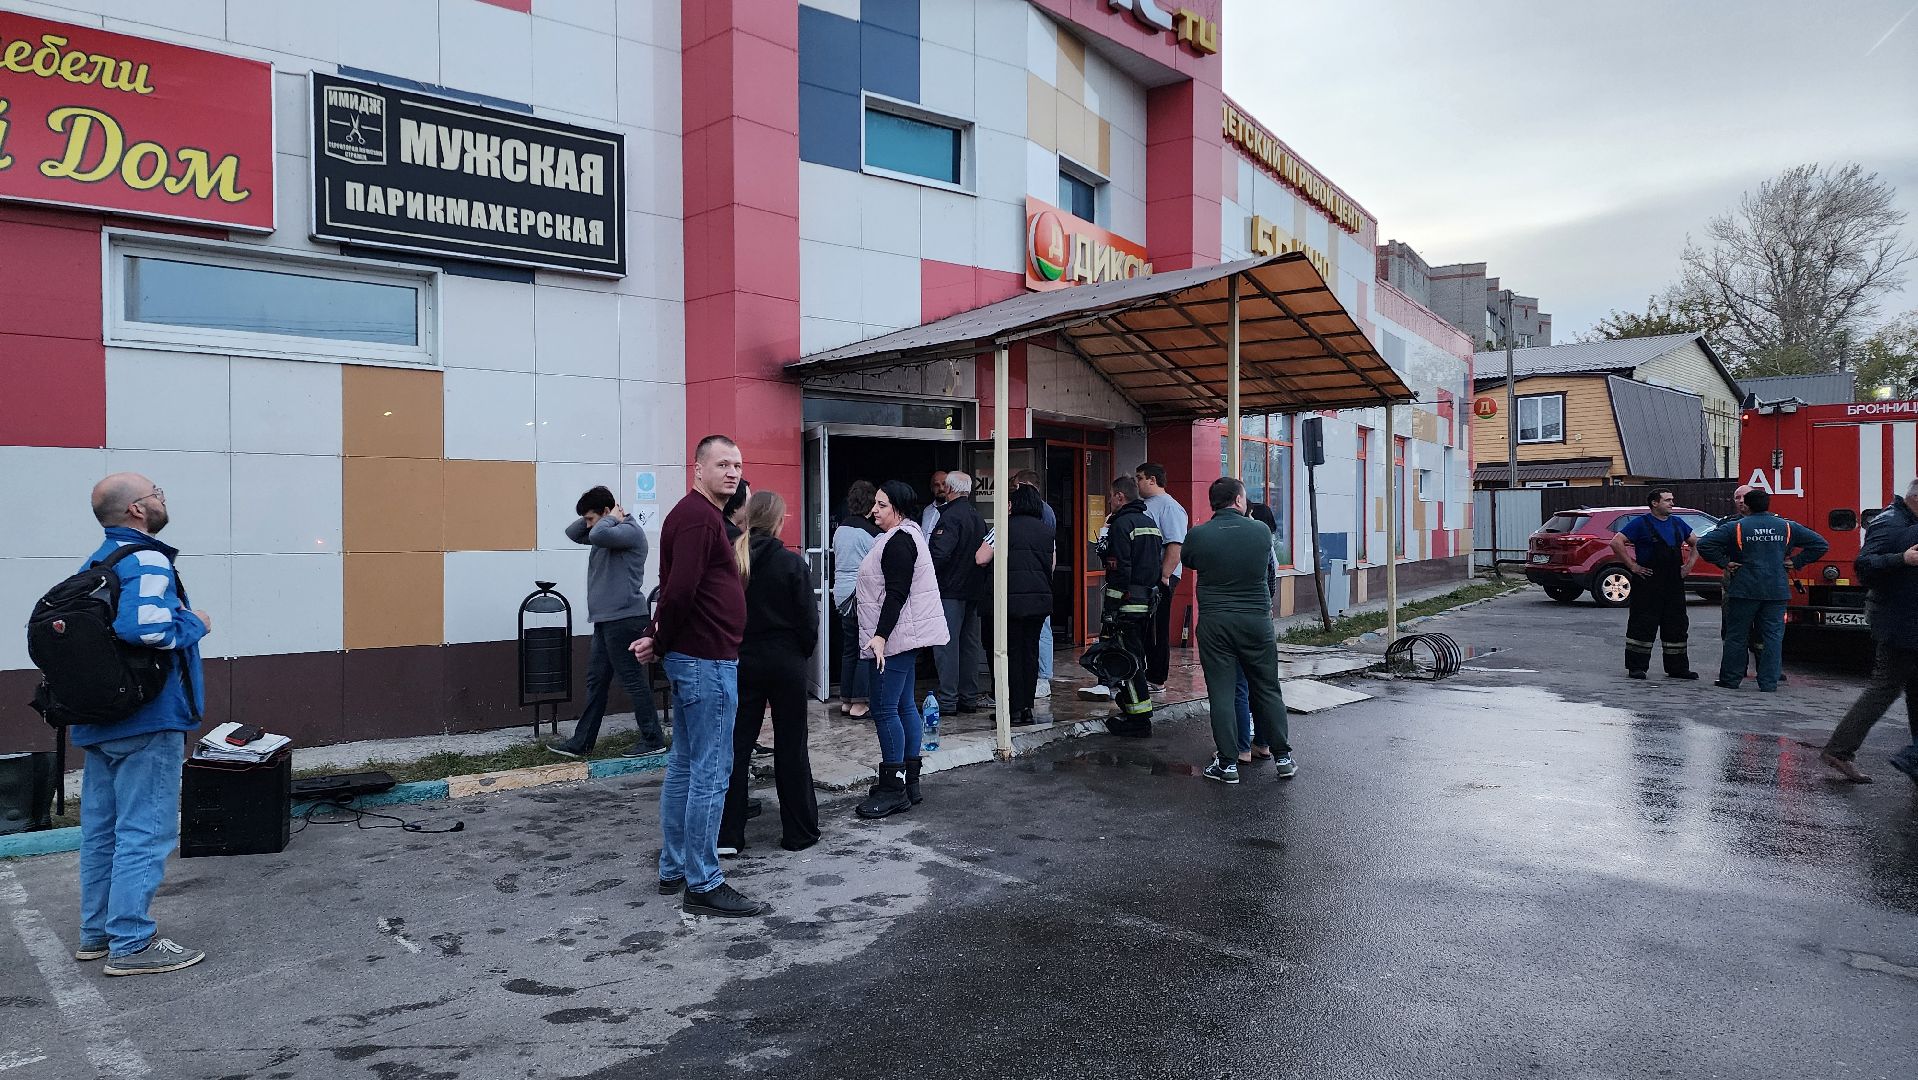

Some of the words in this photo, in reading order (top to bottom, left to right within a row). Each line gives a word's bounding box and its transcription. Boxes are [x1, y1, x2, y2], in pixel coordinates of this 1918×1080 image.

[0, 34, 155, 95] ебели
[328, 90, 382, 115] ИМИДЖ
[39, 106, 250, 202] Дом
[400, 118, 604, 196] МУЖСКАЯ
[345, 181, 604, 246] ПАРИКМАХЕРСКАЯ
[1284, 150, 1334, 213] ИГРОВОЙ
[1335, 196, 1366, 233] ЦЕНТР
[1480, 401, 1491, 413] Д
[1847, 402, 1918, 416] БРОННИЦ
[1747, 467, 1804, 497] АЦ
[1828, 613, 1868, 624] К454Т
